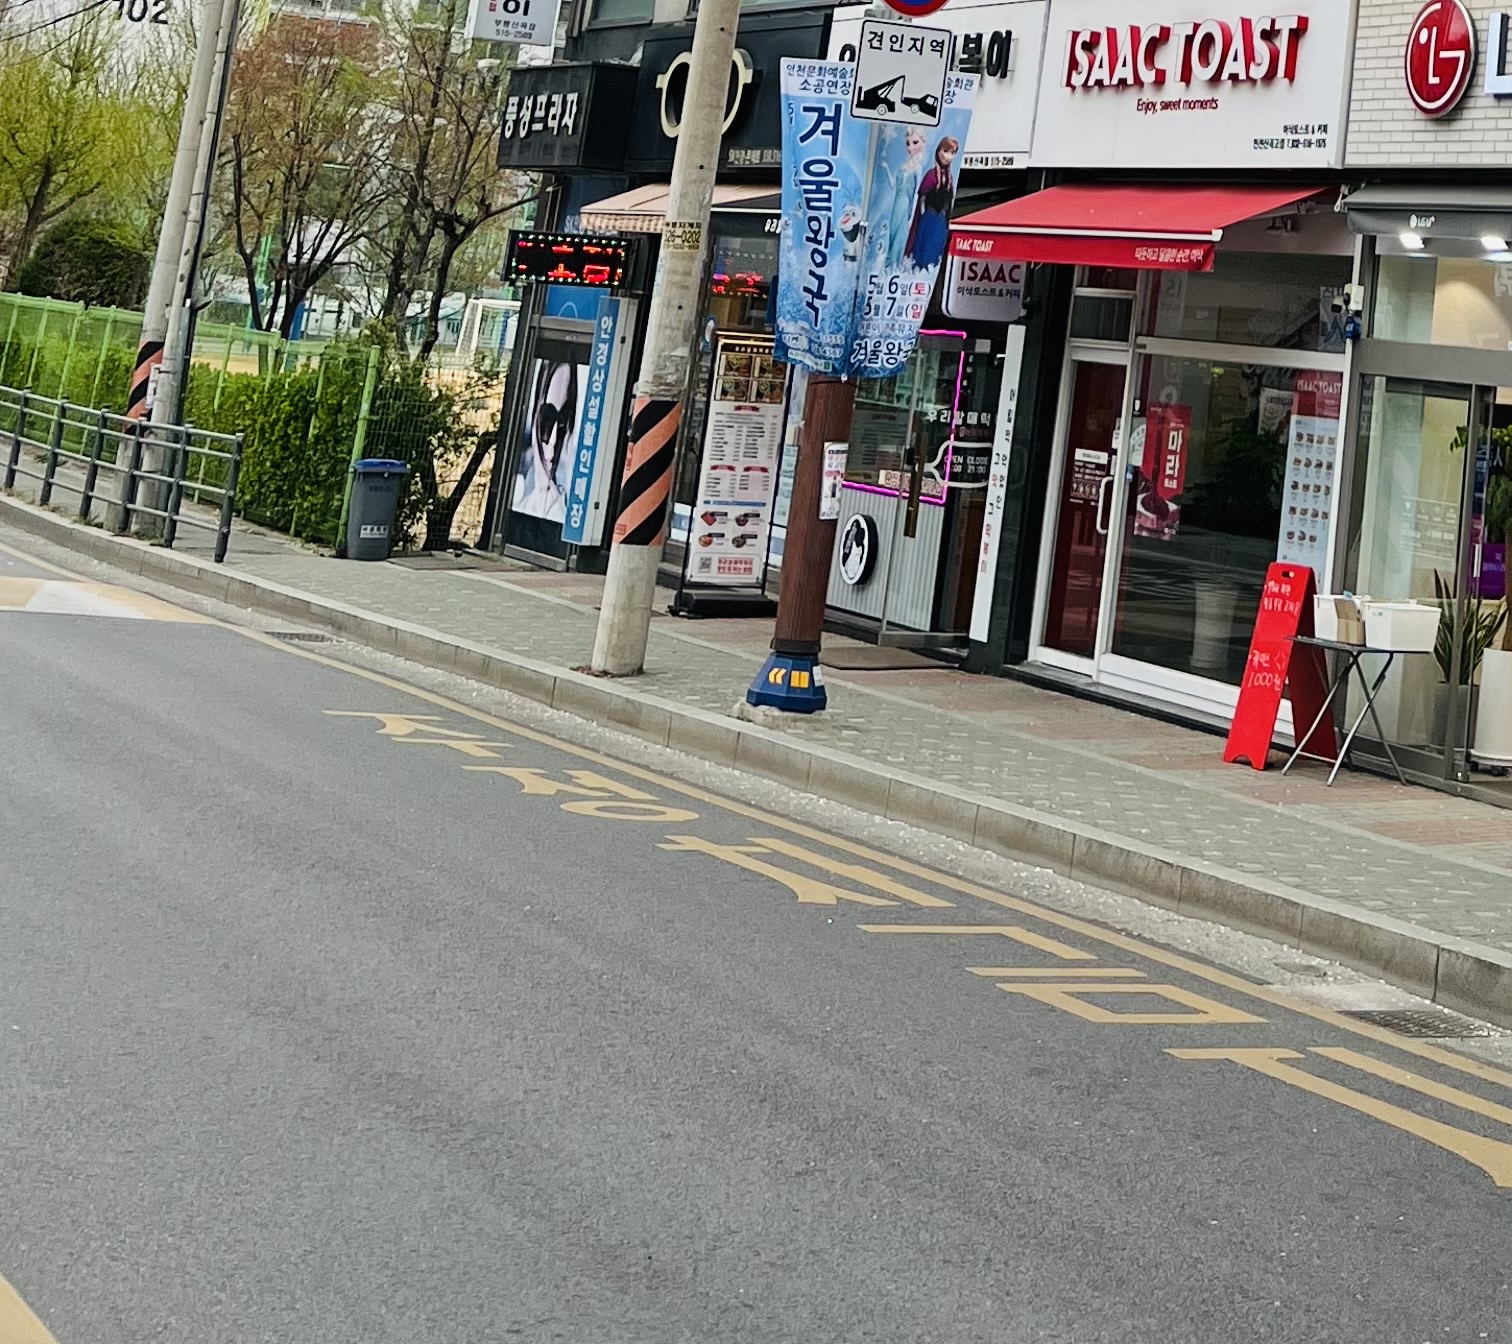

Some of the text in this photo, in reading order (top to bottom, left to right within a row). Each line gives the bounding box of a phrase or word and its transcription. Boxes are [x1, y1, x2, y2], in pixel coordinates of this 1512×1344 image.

[866, 30, 946, 59] 견인지역
[1061, 23, 1171, 90] ISAAC
[1172, 14, 1309, 85] TOAST
[798, 80, 852, 96] 소공연장
[504, 90, 580, 141] 풍성프라자
[799, 102, 843, 328] 겨울왕국
[960, 261, 1022, 285] ISAAC
